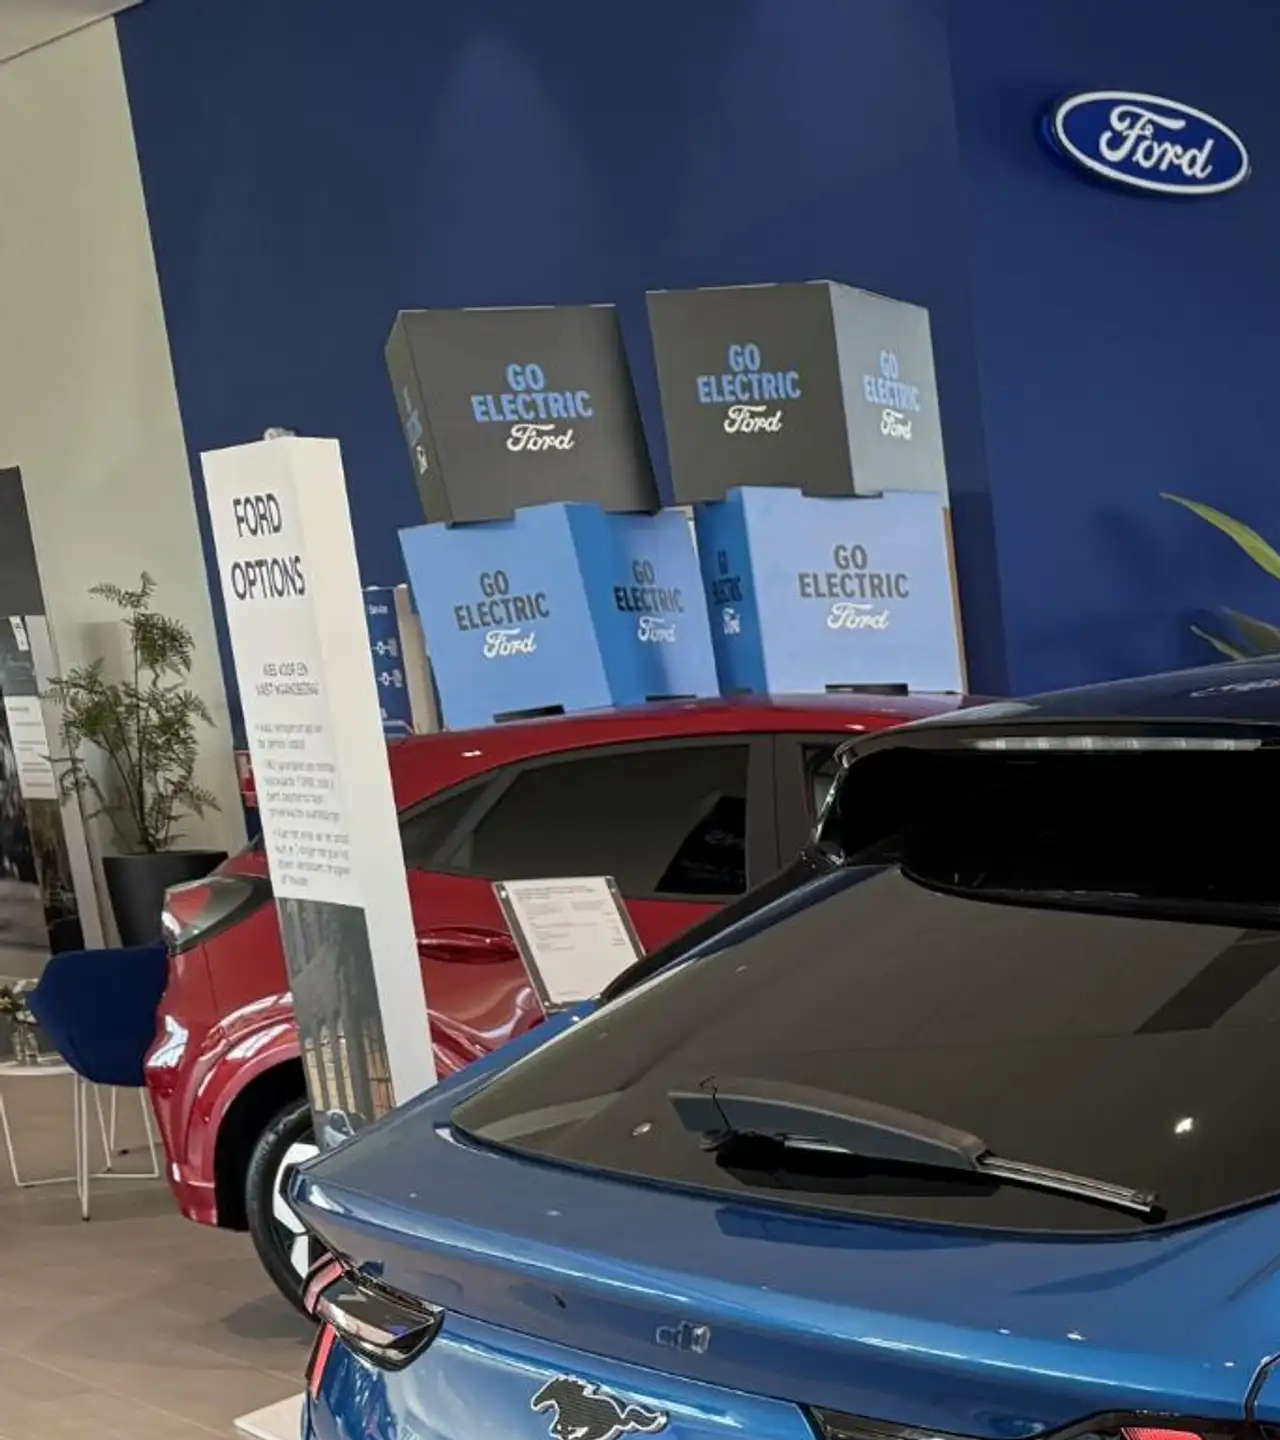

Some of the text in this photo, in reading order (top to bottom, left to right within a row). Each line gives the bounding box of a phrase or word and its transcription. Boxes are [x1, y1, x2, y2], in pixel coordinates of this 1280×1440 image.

[1098, 104, 1215, 180] Ford
[728, 342, 761, 373] GO
[879, 349, 899, 378] GO
[506, 362, 546, 392] GO
[696, 371, 802, 404] ELECTRIC
[470, 390, 594, 423] ELECTRIC
[862, 374, 921, 412] ELECTRIC
[723, 404, 783, 434] Ford
[880, 408, 913, 441] Ford
[506, 422, 575, 452] Ford
[232, 492, 283, 538] FORD
[631, 559, 656, 585] GO
[833, 544, 868, 571] GO
[230, 554, 306, 601] OPTIONS
[479, 569, 510, 599] GO
[798, 572, 910, 600] ELECTRIC
[453, 592, 551, 632] ELECTRIC
[613, 585, 685, 615] ELECTRIC
[636, 615, 678, 643] Ford
[826, 602, 890, 630] Ford
[482, 627, 538, 659] Ford
